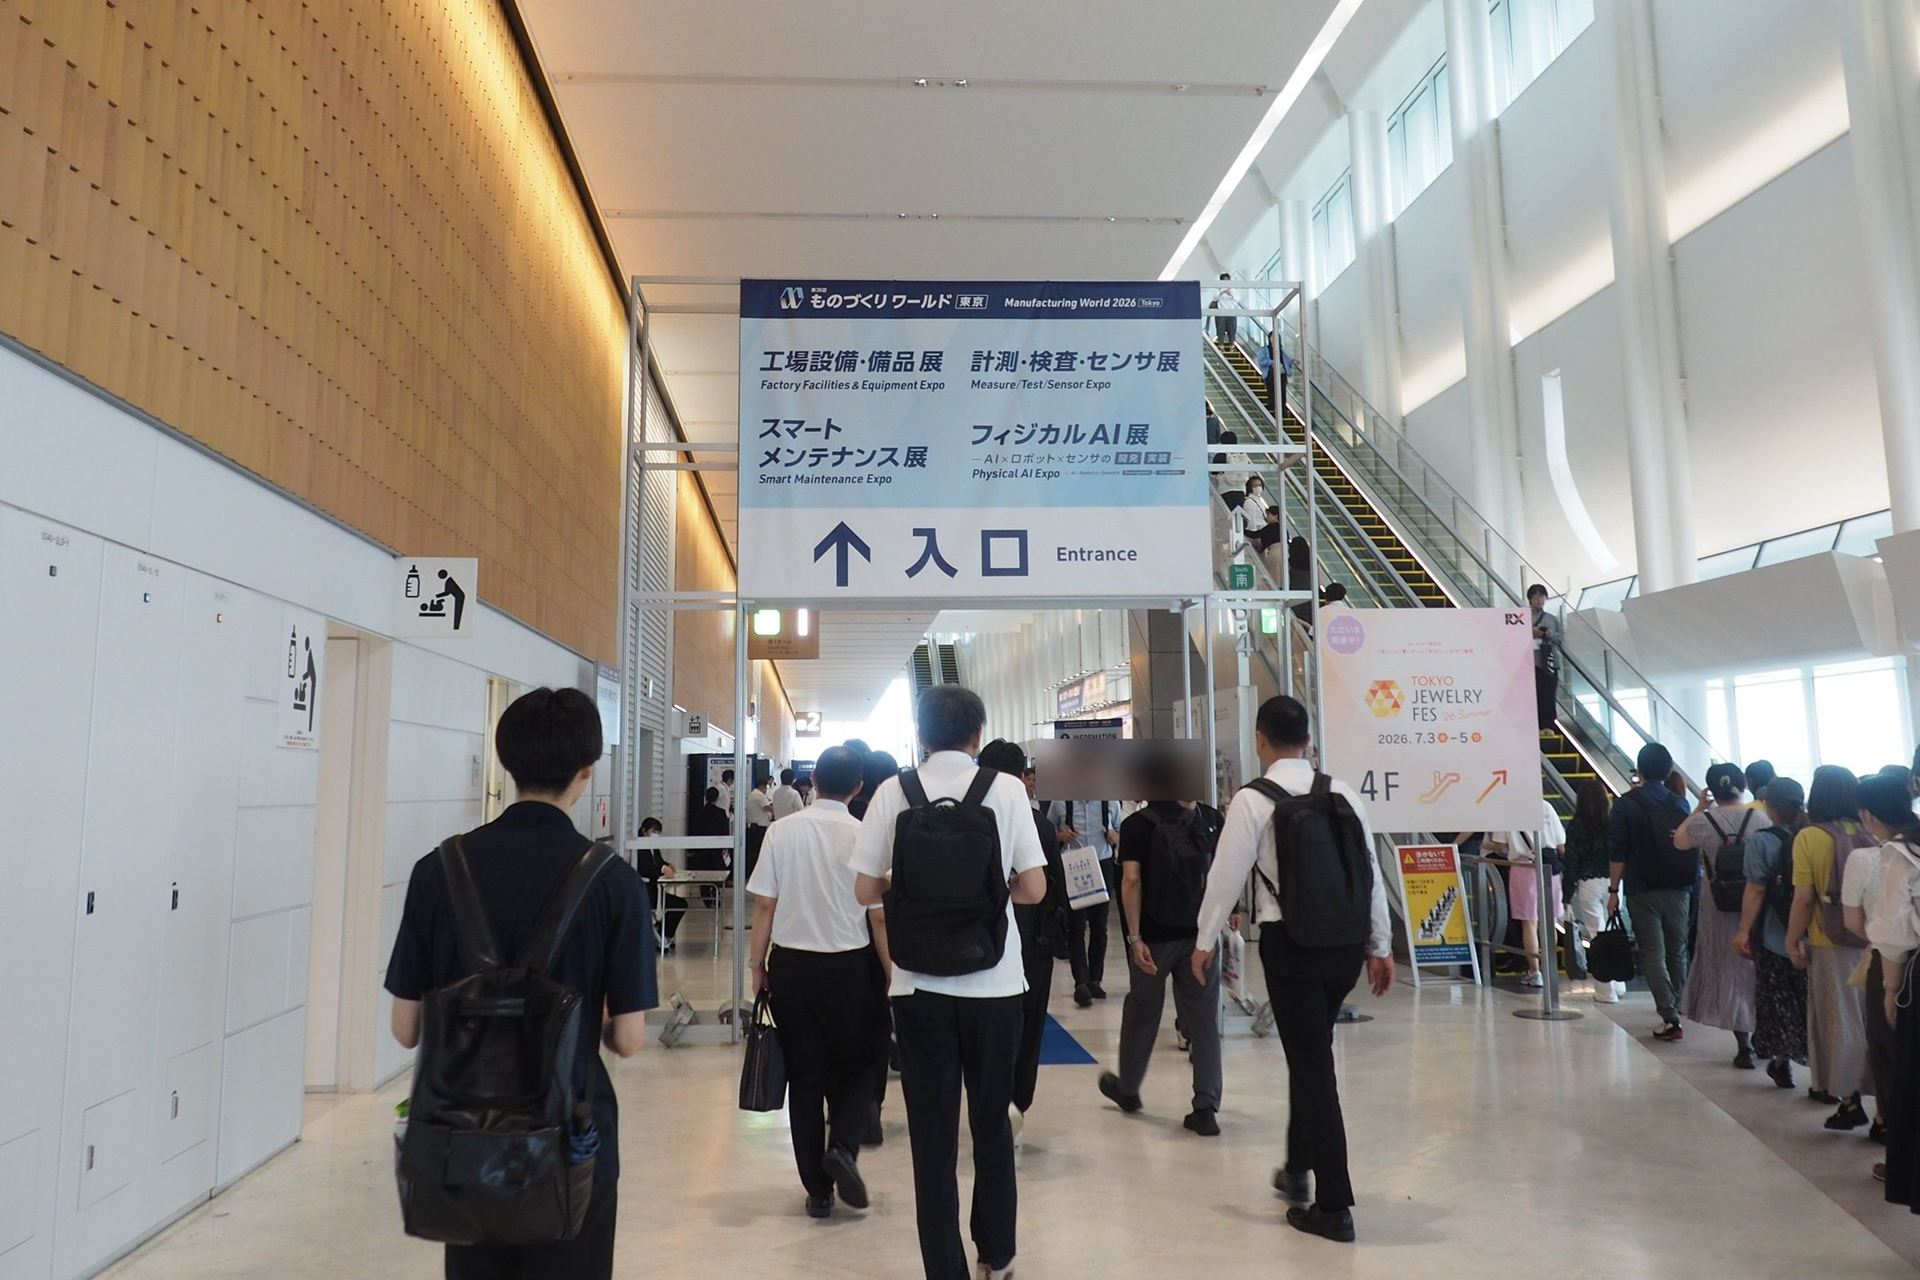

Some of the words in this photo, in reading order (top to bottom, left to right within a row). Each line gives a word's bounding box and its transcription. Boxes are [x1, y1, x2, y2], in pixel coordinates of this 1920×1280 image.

[811, 294, 887, 309] ものづくり
[892, 294, 952, 309] ワールド
[959, 296, 985, 308] 東京
[1004, 298, 1077, 310] Manufacturing
[1079, 298, 1110, 308] World
[1112, 298, 1137, 308] 2026
[1141, 299, 1161, 308] Tokyo
[760, 379, 801, 392] Factory
[802, 380, 850, 390] Facilities
[851, 381, 860, 390] &
[861, 380, 918, 392] Equipment
[919, 380, 945, 392] Expo
[971, 379, 1085, 390] Measure/Test/Sensor
[1086, 380, 1111, 391] Expo
[759, 418, 842, 440] スマート
[759, 446, 929, 468] メンテナンス展
[759, 474, 791, 484] Smart
[794, 474, 864, 484] Maintenance
[867, 474, 892, 486] Expo
[972, 469, 1018, 481] Physical
[1020, 469, 1033, 478] AI
[1035, 469, 1060, 481] Expo
[904, 528, 1029, 579] 入口
[1056, 546, 1137, 562] Entrance
[1235, 573, 1248, 587] 南
[1505, 613, 1525, 626] RX
[1411, 676, 1454, 687] TOKYO
[1411, 689, 1482, 704] JEWELRY
[807, 712, 820, 732] 2
[1412, 707, 1438, 722] FES
[1360, 770, 1400, 802] 4F
